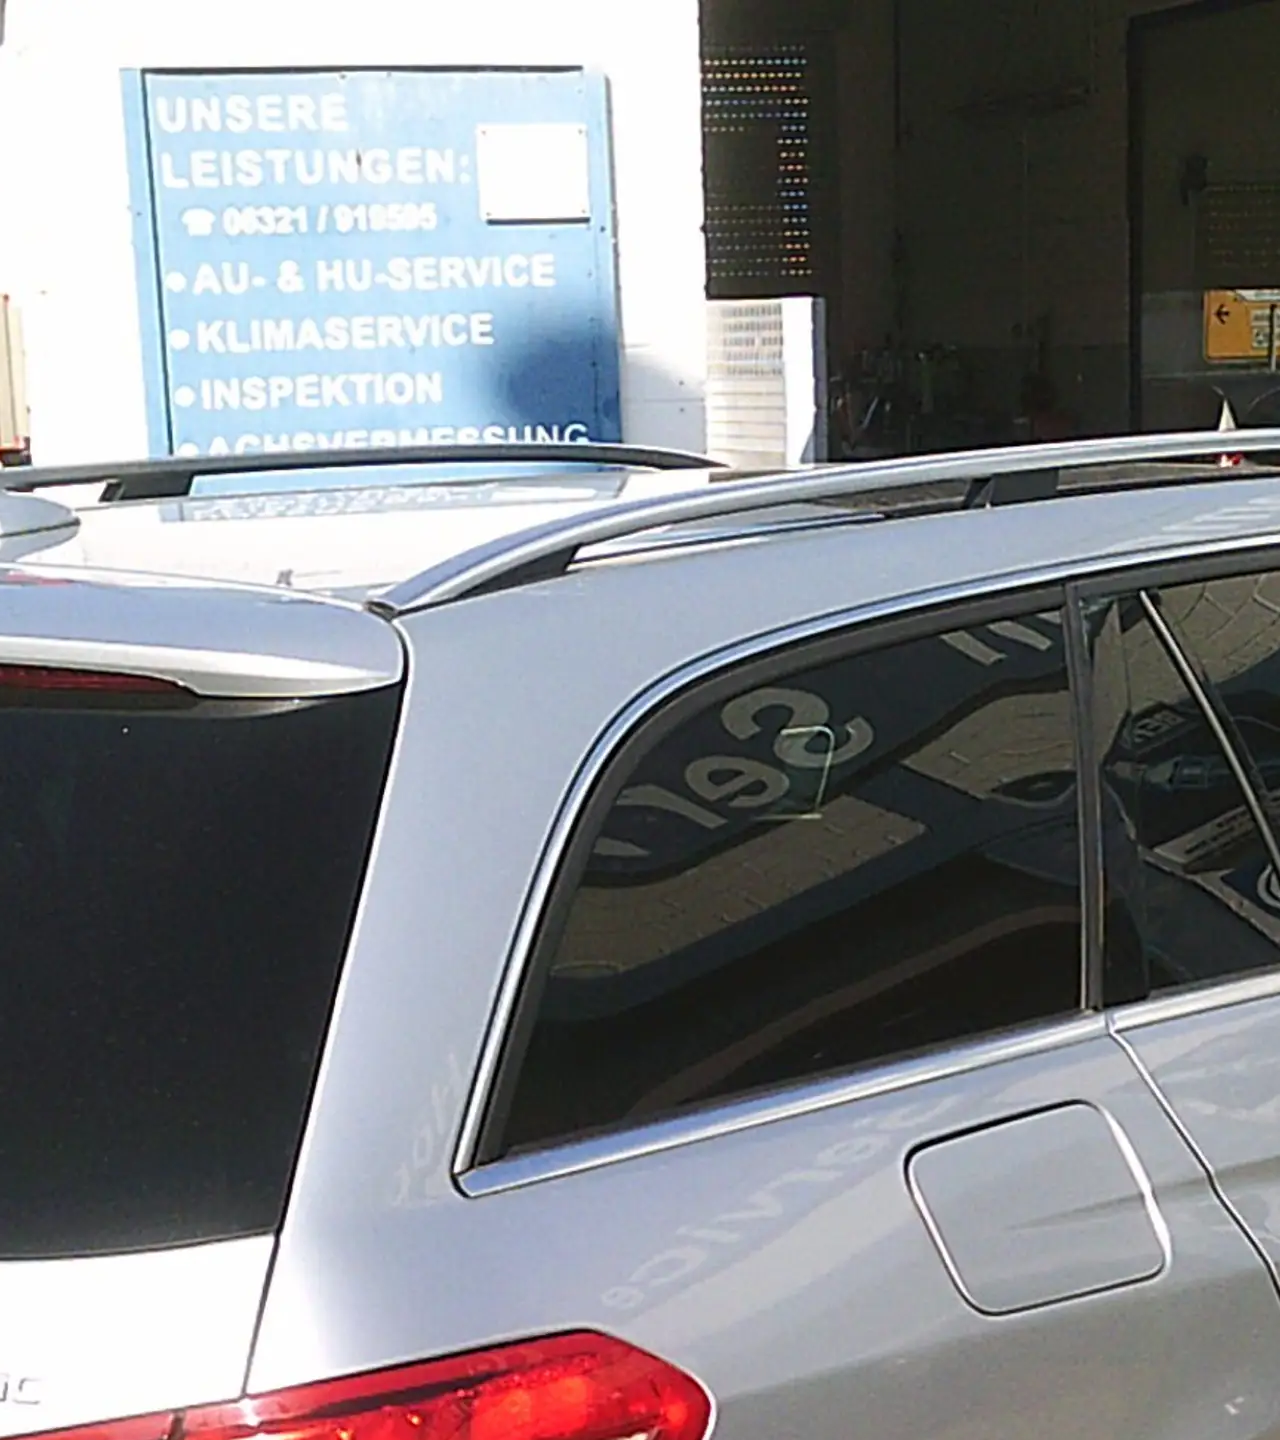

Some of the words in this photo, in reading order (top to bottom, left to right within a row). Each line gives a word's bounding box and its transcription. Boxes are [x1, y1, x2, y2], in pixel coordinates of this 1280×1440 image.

[156, 93, 349, 133] UNSERE
[161, 148, 470, 188] LEISTUNGEN:
[192, 262, 265, 295] AU-
[276, 260, 304, 292] &
[316, 253, 556, 291] HU-SERVICE
[196, 313, 494, 353] KLIMASERVICE
[201, 372, 442, 409] INSPEKTION
